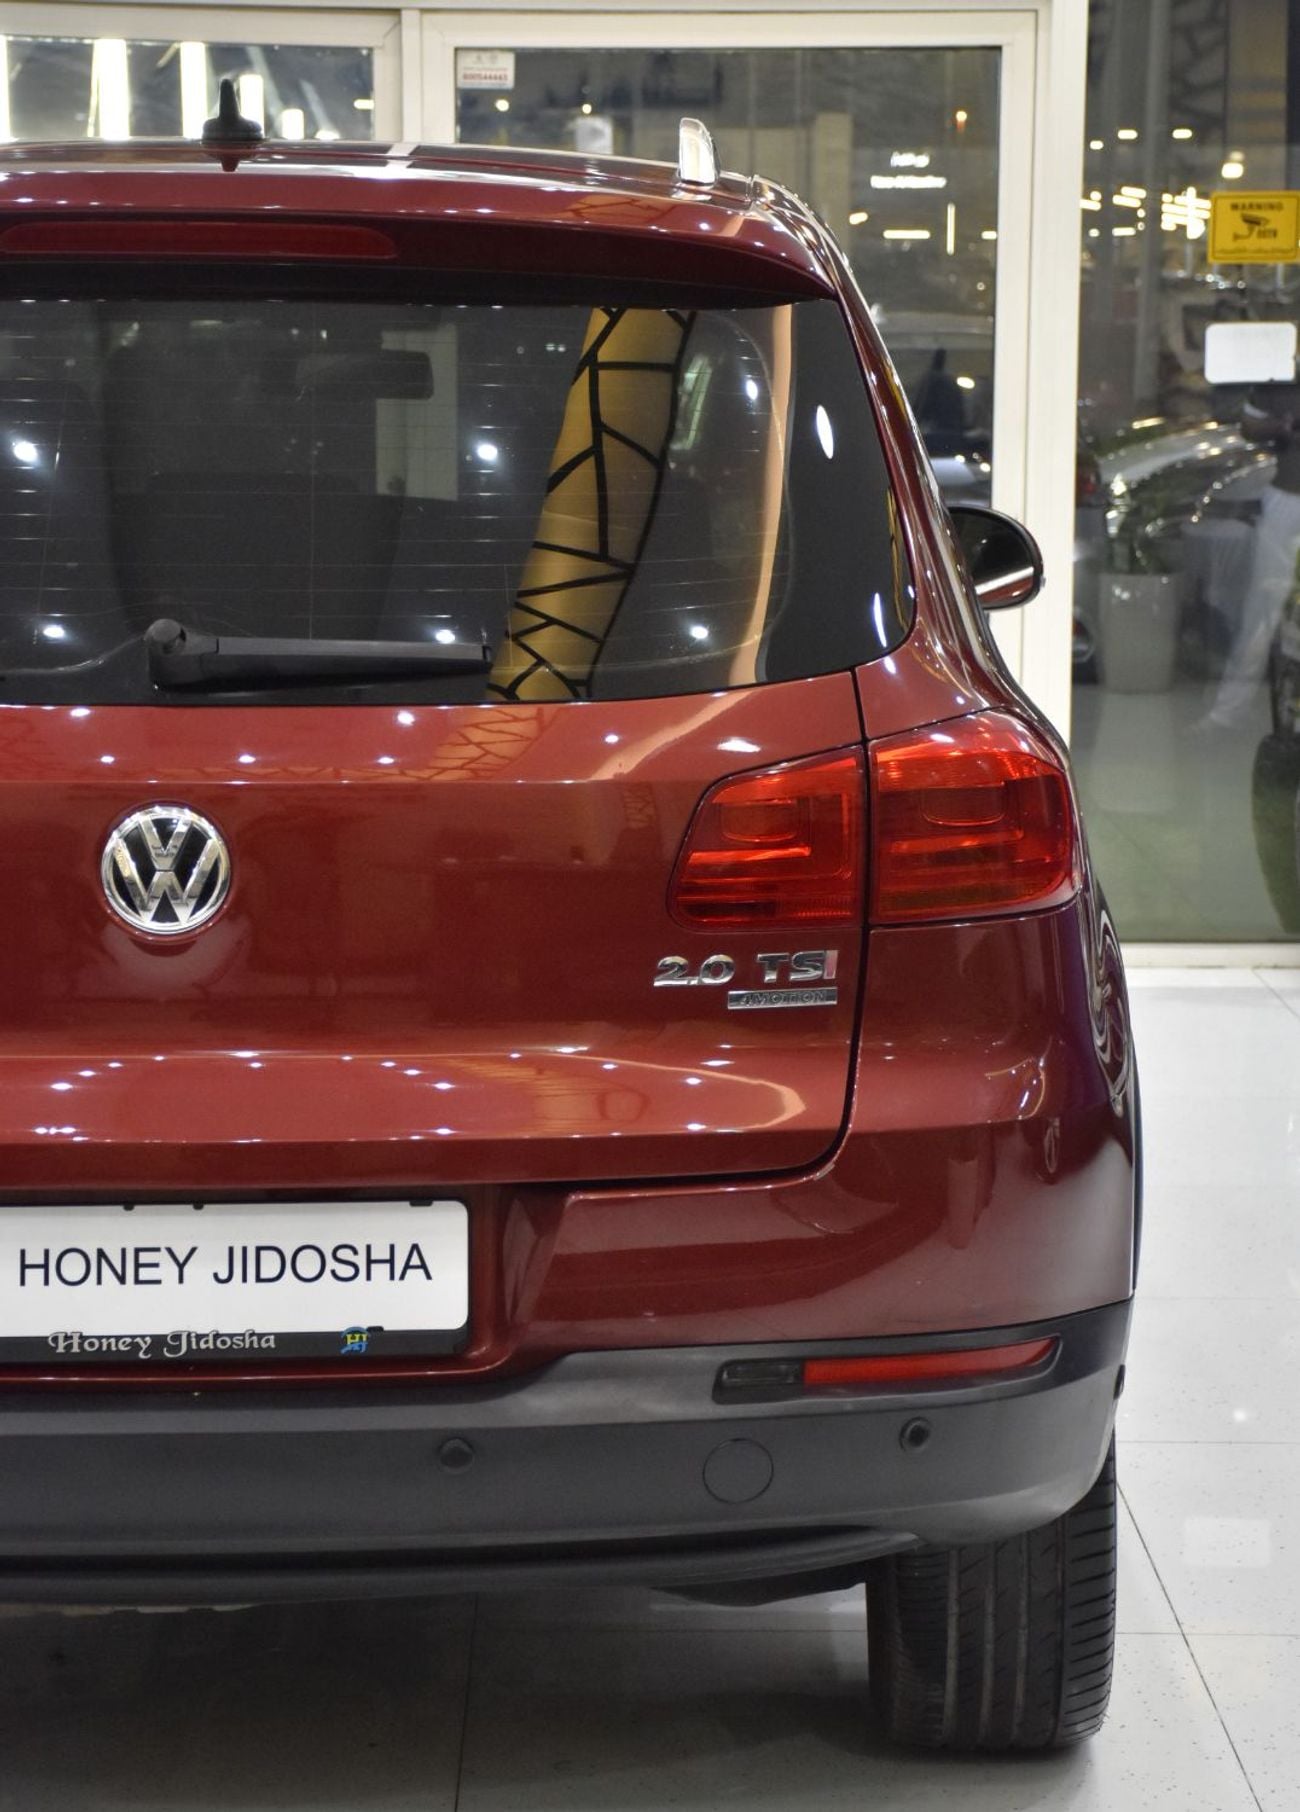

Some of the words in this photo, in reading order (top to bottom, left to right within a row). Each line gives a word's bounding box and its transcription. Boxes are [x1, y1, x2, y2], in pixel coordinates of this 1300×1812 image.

[653, 954, 736, 987] 2.0
[757, 949, 838, 984] TSI
[737, 989, 830, 1007] 4MOTION
[18, 1246, 198, 1287] HONEY
[212, 1242, 433, 1285] JIDOSHA
[48, 1330, 153, 1359] Honey
[163, 1329, 277, 1359] Jidosha
